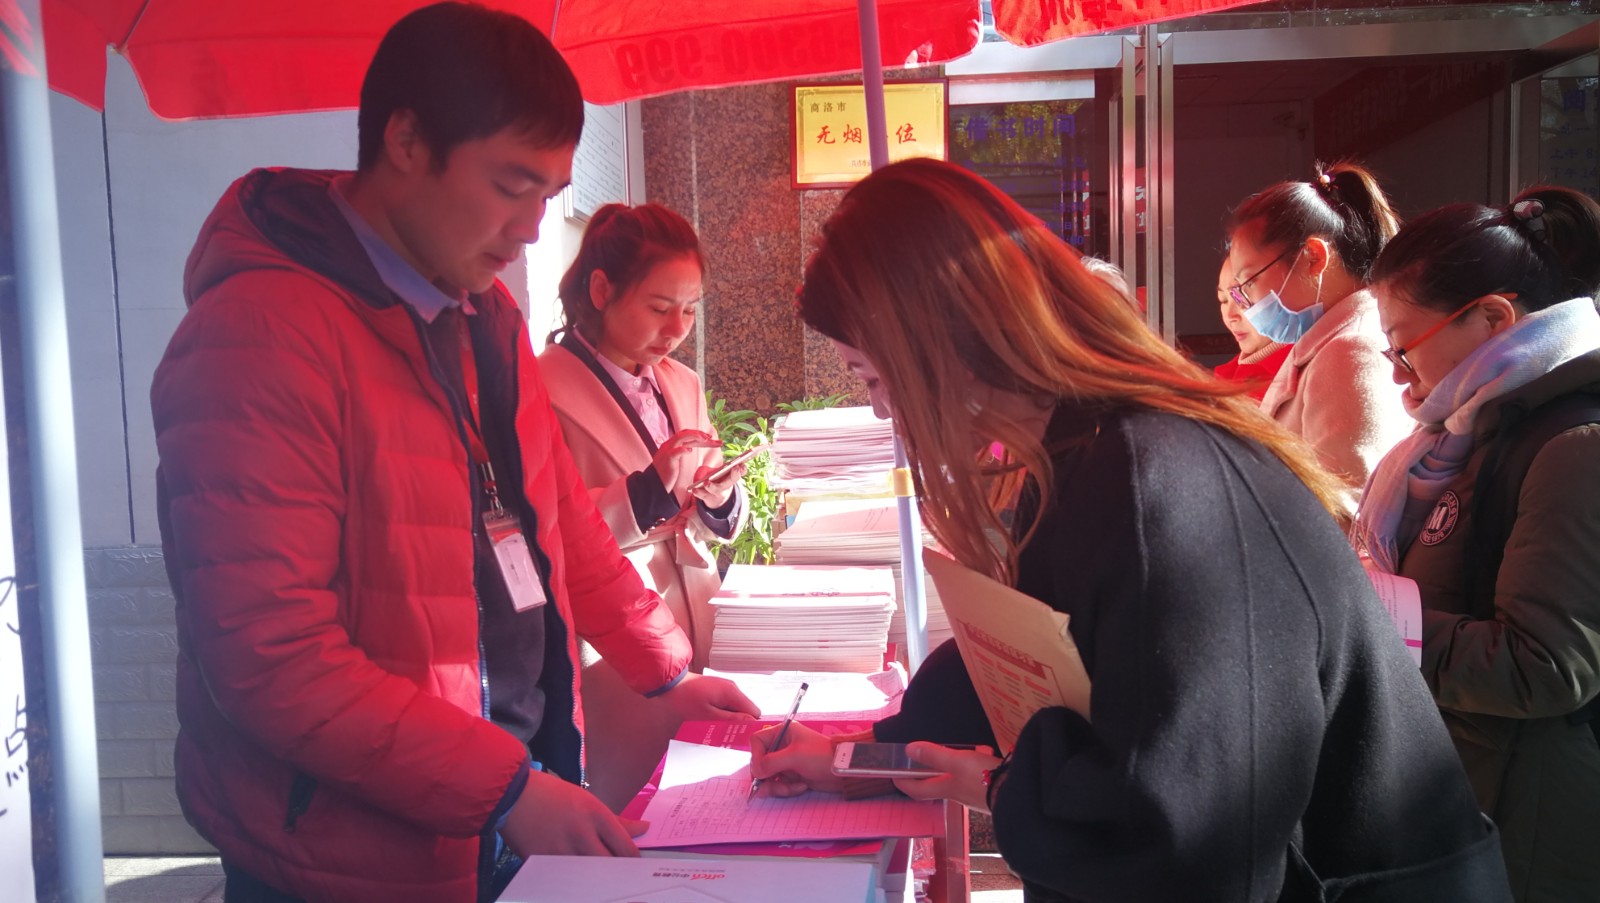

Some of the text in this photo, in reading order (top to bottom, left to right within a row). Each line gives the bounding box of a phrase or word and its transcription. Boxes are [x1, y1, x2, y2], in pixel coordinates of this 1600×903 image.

[810, 101, 847, 113] 商洛市
[816, 123, 917, 144] 无烟位
[965, 114, 1076, 140] 借书时间
